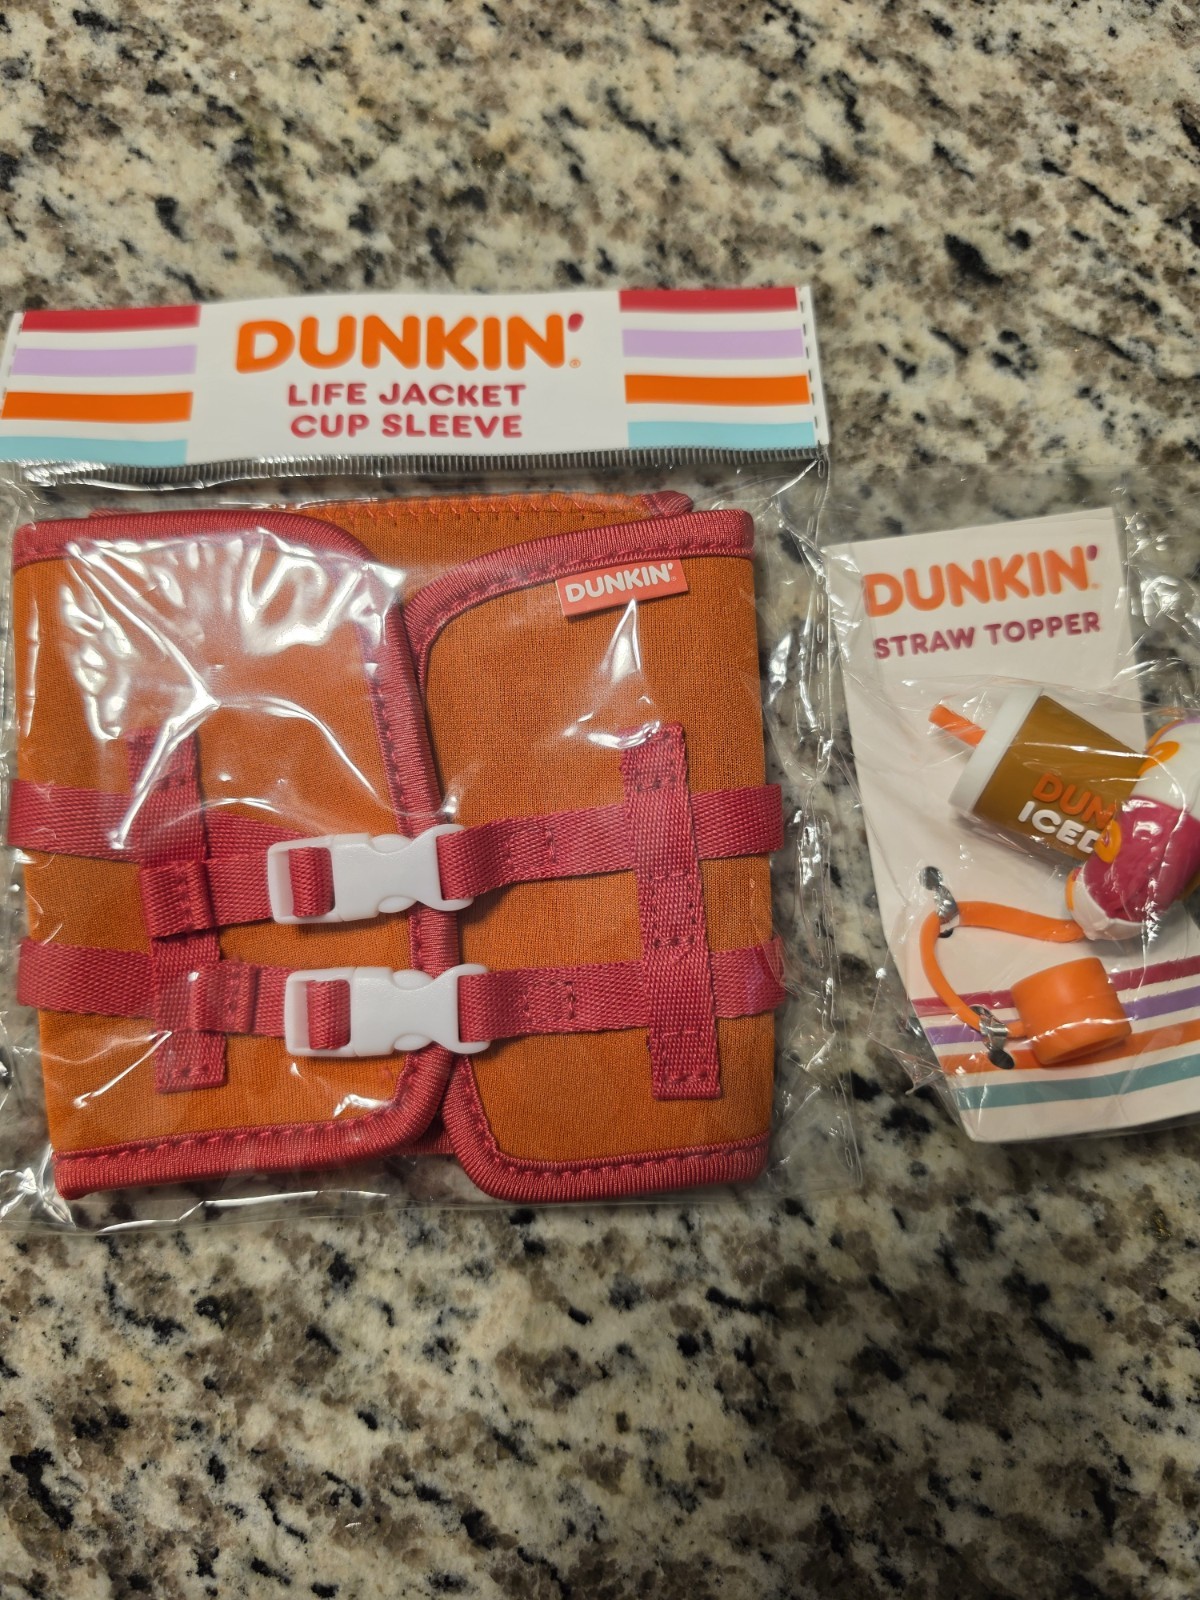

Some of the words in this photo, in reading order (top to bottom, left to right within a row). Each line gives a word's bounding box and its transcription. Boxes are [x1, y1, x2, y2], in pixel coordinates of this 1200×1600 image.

[235, 313, 584, 374] DUNKIN'
[287, 383, 367, 407] LIFE
[379, 382, 528, 407] JACKET
[290, 413, 369, 439] CUP
[380, 413, 523, 439] SLEEVE
[565, 562, 674, 603] DUNKIN'
[862, 545, 1099, 618] DUNKIN'
[873, 626, 975, 660] STRAW
[983, 611, 1101, 646] TOPPER
